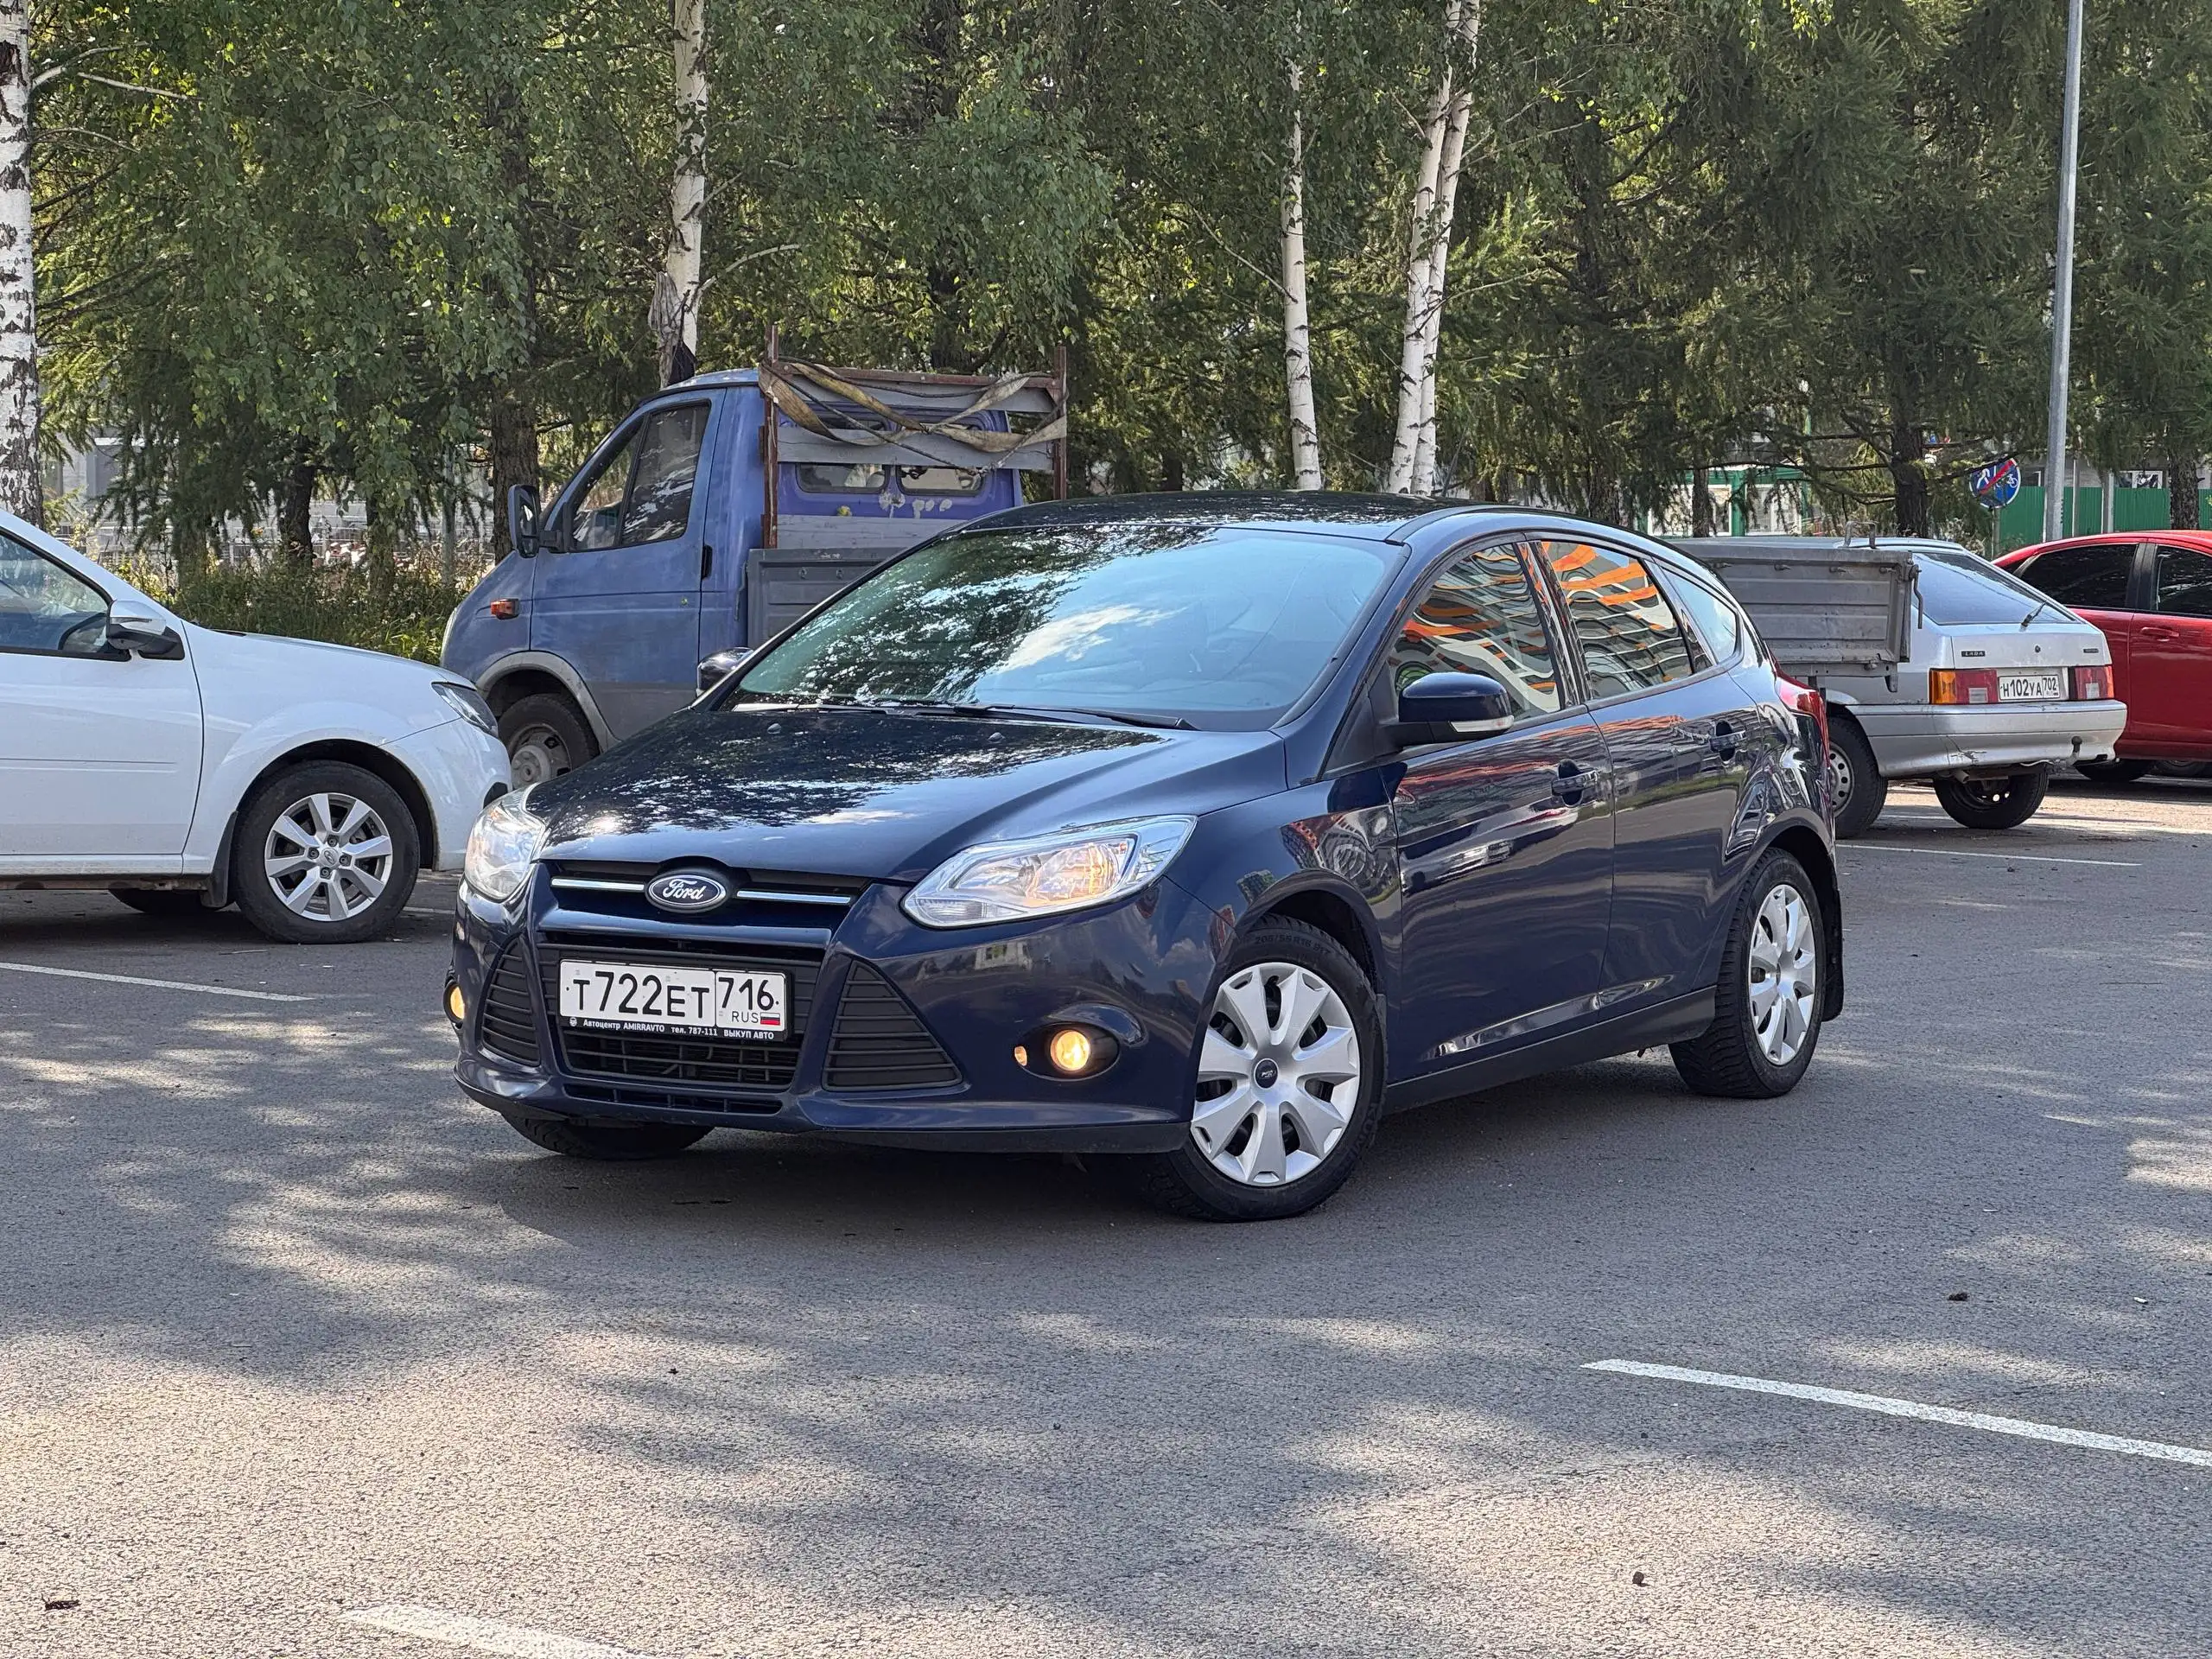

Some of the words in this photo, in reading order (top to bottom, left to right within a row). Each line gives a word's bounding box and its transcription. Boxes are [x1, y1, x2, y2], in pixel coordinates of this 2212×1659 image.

[2002, 678, 2043, 697] Н102УА
[2043, 677, 2056, 691] 702
[662, 878, 707, 900] Ford
[573, 970, 710, 1019] Т722ЕТ
[718, 976, 774, 1011] 716
[731, 1010, 760, 1024] RUS
[582, 1019, 621, 1031] Автоцентр
[623, 1022, 665, 1033] AMIRRAVTO
[688, 1027, 718, 1037] 787-111
[723, 1029, 752, 1039] ВЫКУП
[753, 1031, 774, 1040] АВТО
